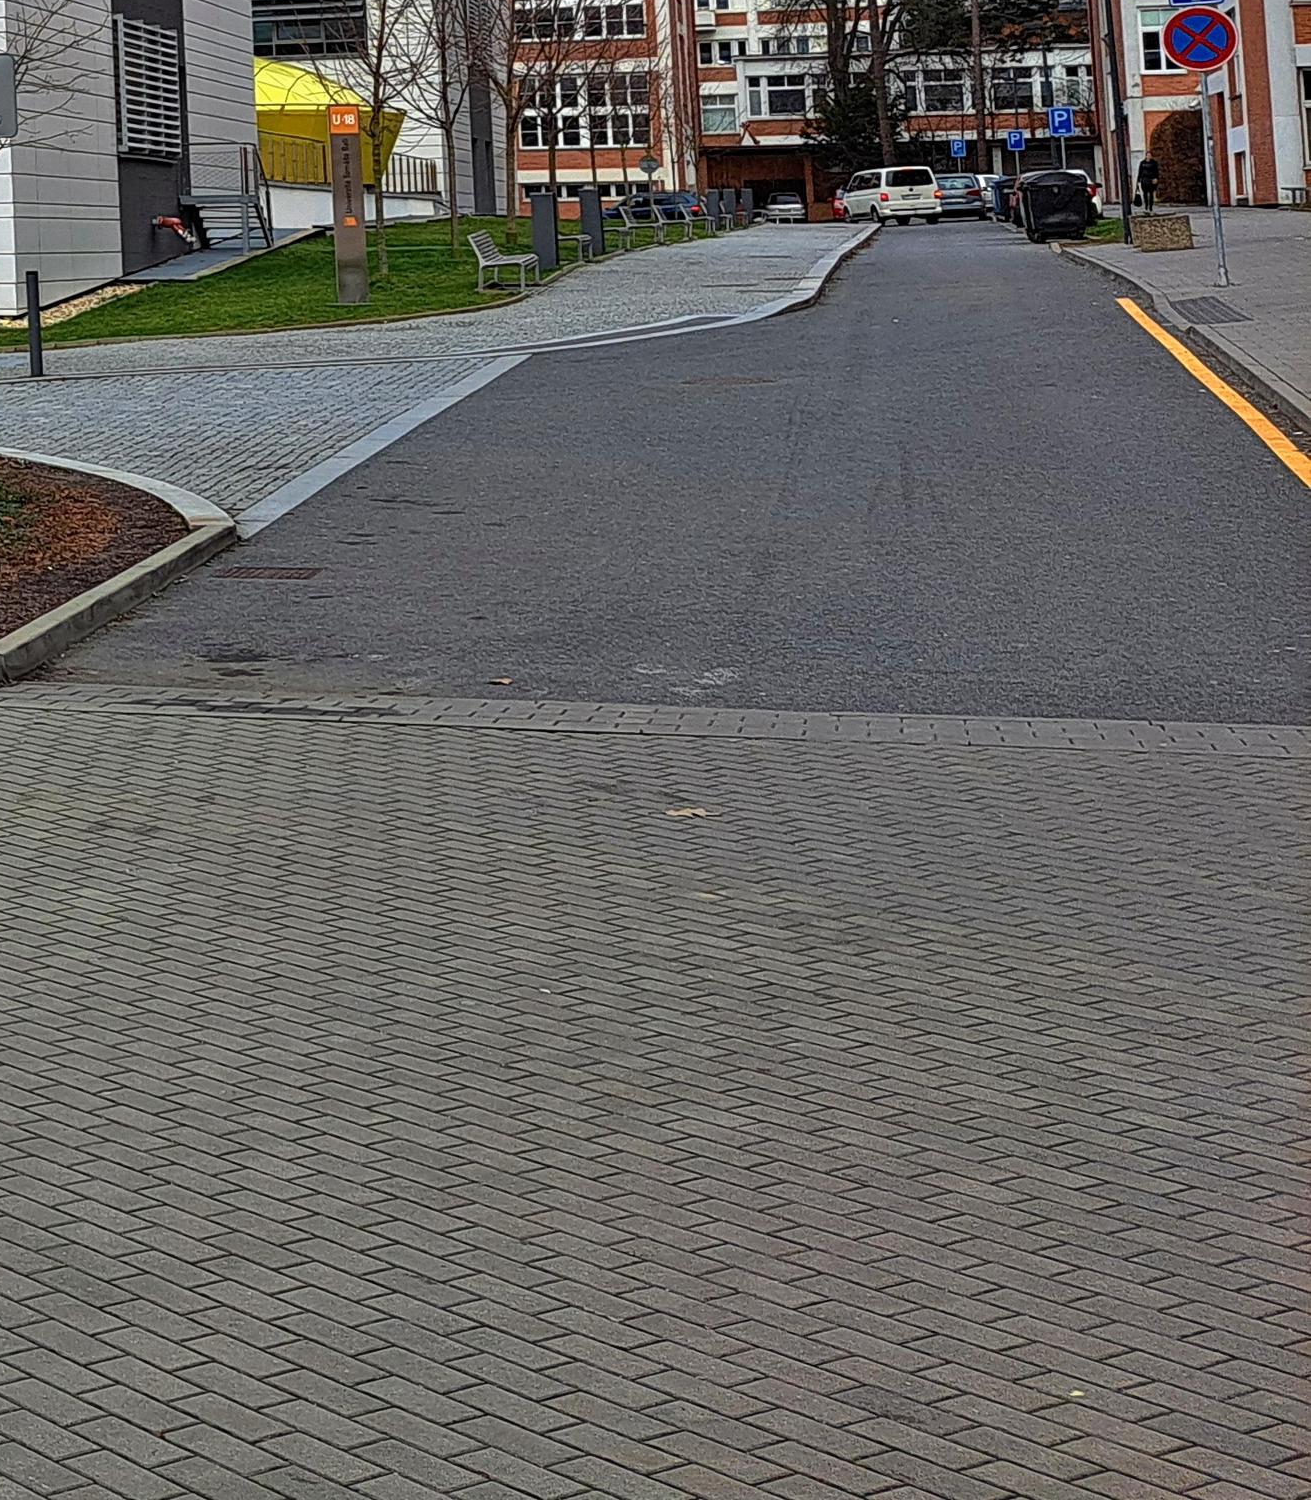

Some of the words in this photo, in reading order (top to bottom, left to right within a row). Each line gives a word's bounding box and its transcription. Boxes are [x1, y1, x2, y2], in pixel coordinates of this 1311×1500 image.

[1054, 111, 1067, 127] P
[1010, 133, 1020, 144] P
[953, 141, 962, 152] P
